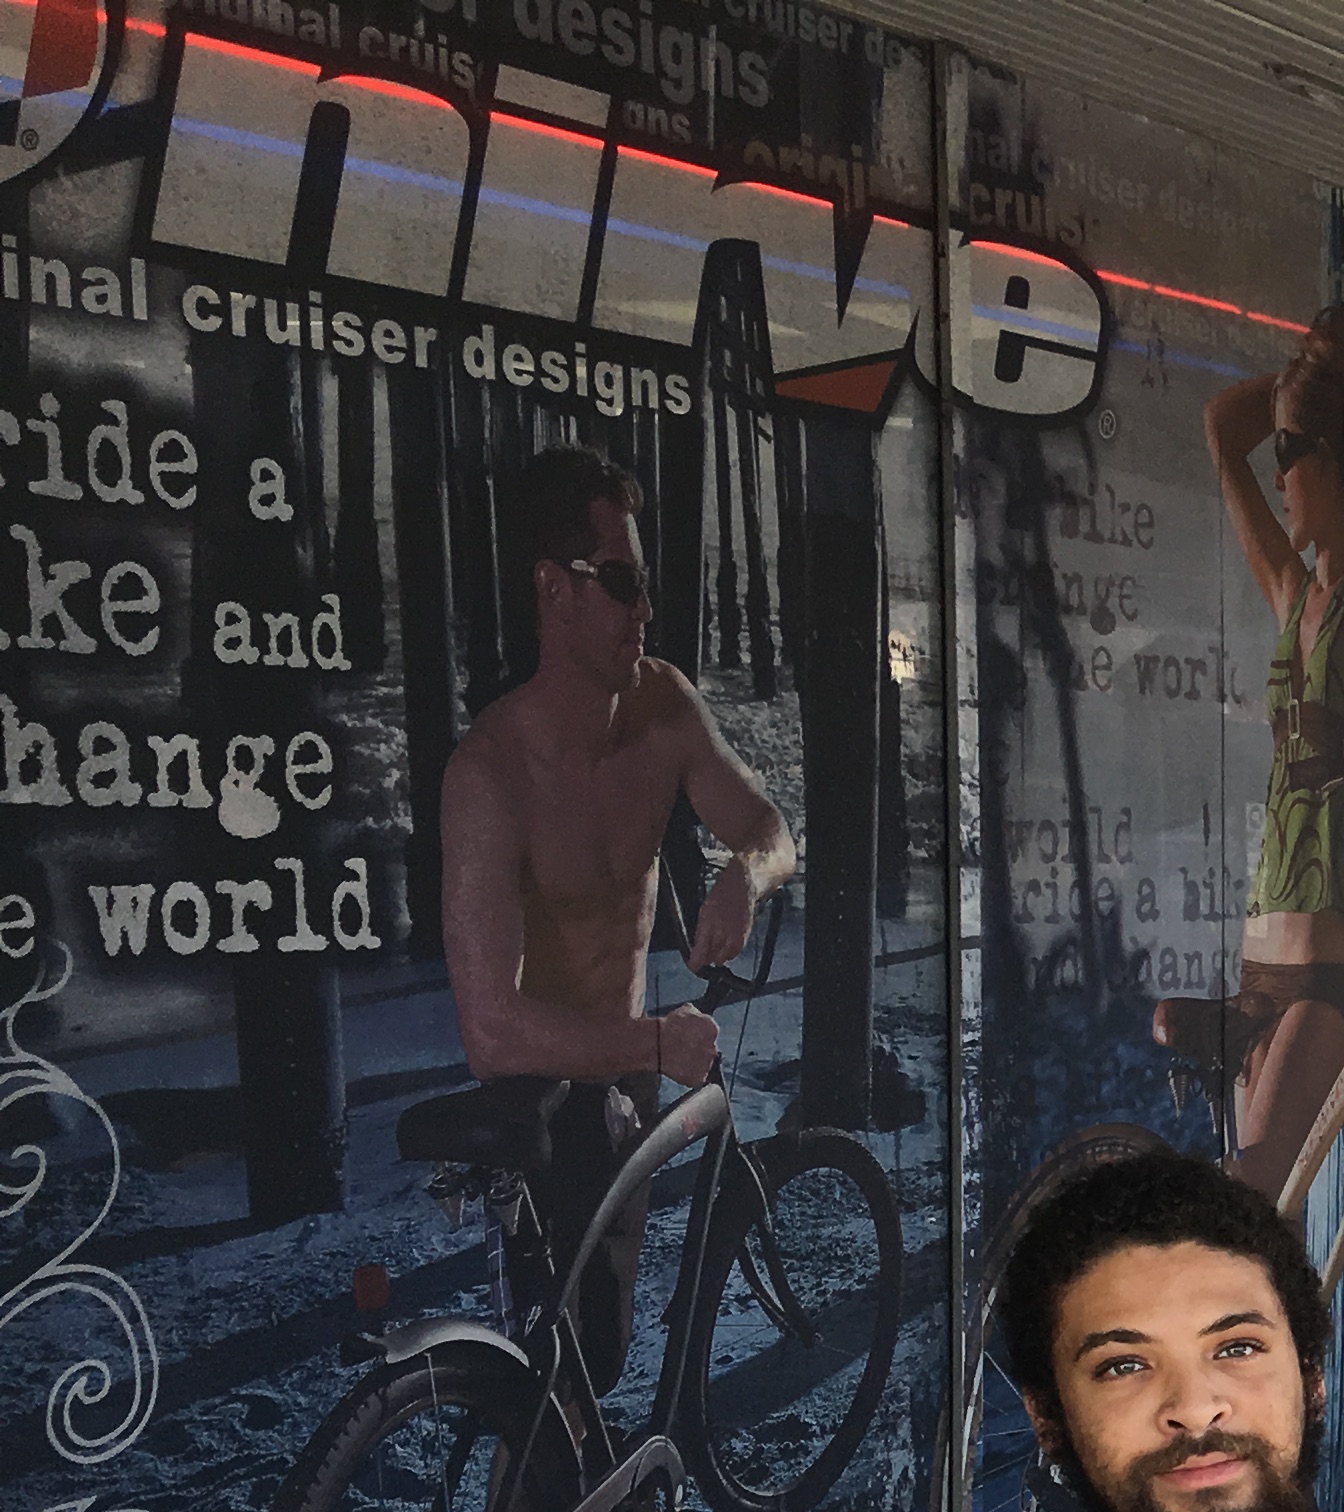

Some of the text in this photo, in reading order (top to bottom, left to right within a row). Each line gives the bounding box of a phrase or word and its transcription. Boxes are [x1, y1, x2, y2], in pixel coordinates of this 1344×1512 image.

[181, 281, 438, 370] cruiser
[462, 325, 693, 416] designs
[0, 393, 293, 523] ide a
[0, 524, 351, 671] ke and
[88, 857, 381, 957] world
